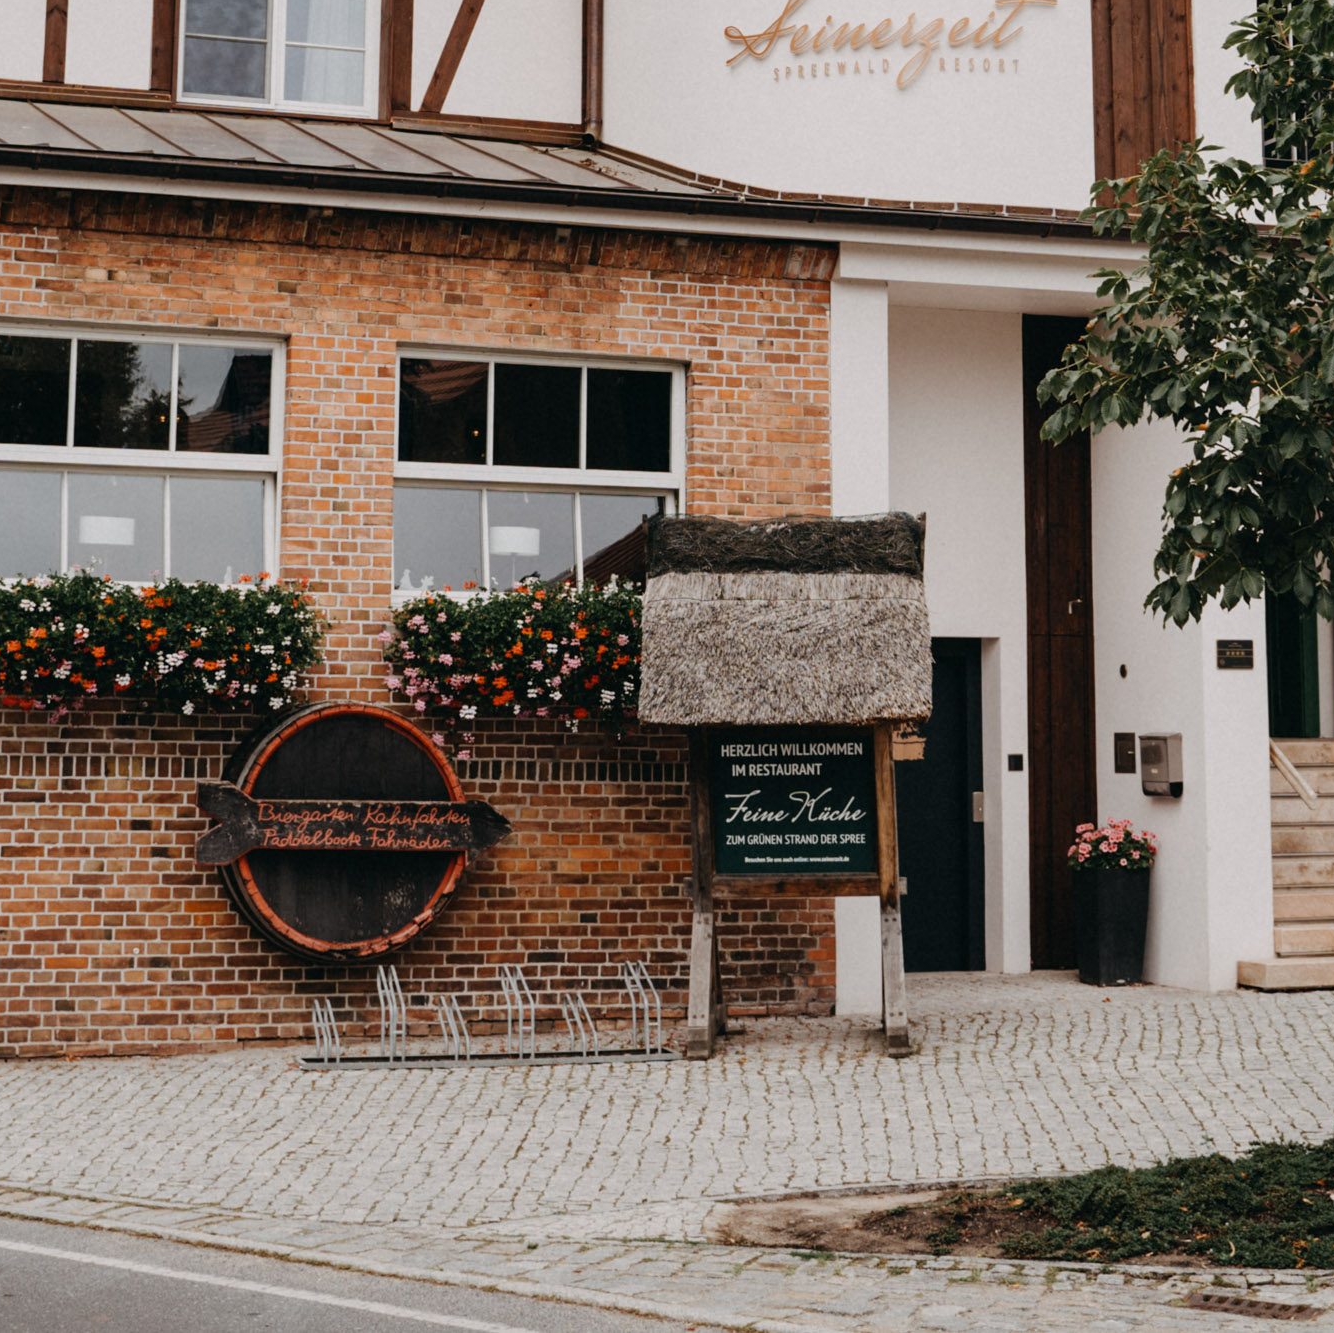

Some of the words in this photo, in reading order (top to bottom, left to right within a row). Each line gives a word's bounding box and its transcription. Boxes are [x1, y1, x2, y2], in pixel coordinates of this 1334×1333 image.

[773, 57, 891, 82] SPREEWALD
[939, 57, 1020, 74] RESORT
[721, 743, 778, 757] HERZLICH
[780, 742, 863, 756] WILLKOMMEN
[731, 764, 746, 777] IM
[748, 763, 823, 776] RESTAURANT
[724, 789, 789, 823] Feine
[789, 787, 866, 823] Küche
[258, 802, 354, 833] Biergarten
[362, 804, 471, 831] Kahnfahrten
[263, 828, 362, 848] Paddelboote
[366, 826, 452, 849] Fahrräder
[726, 835, 745, 845] ZUM
[747, 833, 783, 845] GRÜNEN
[784, 834, 819, 845] STRAND
[820, 834, 838, 844] DER
[839, 833, 866, 844] SPREE
